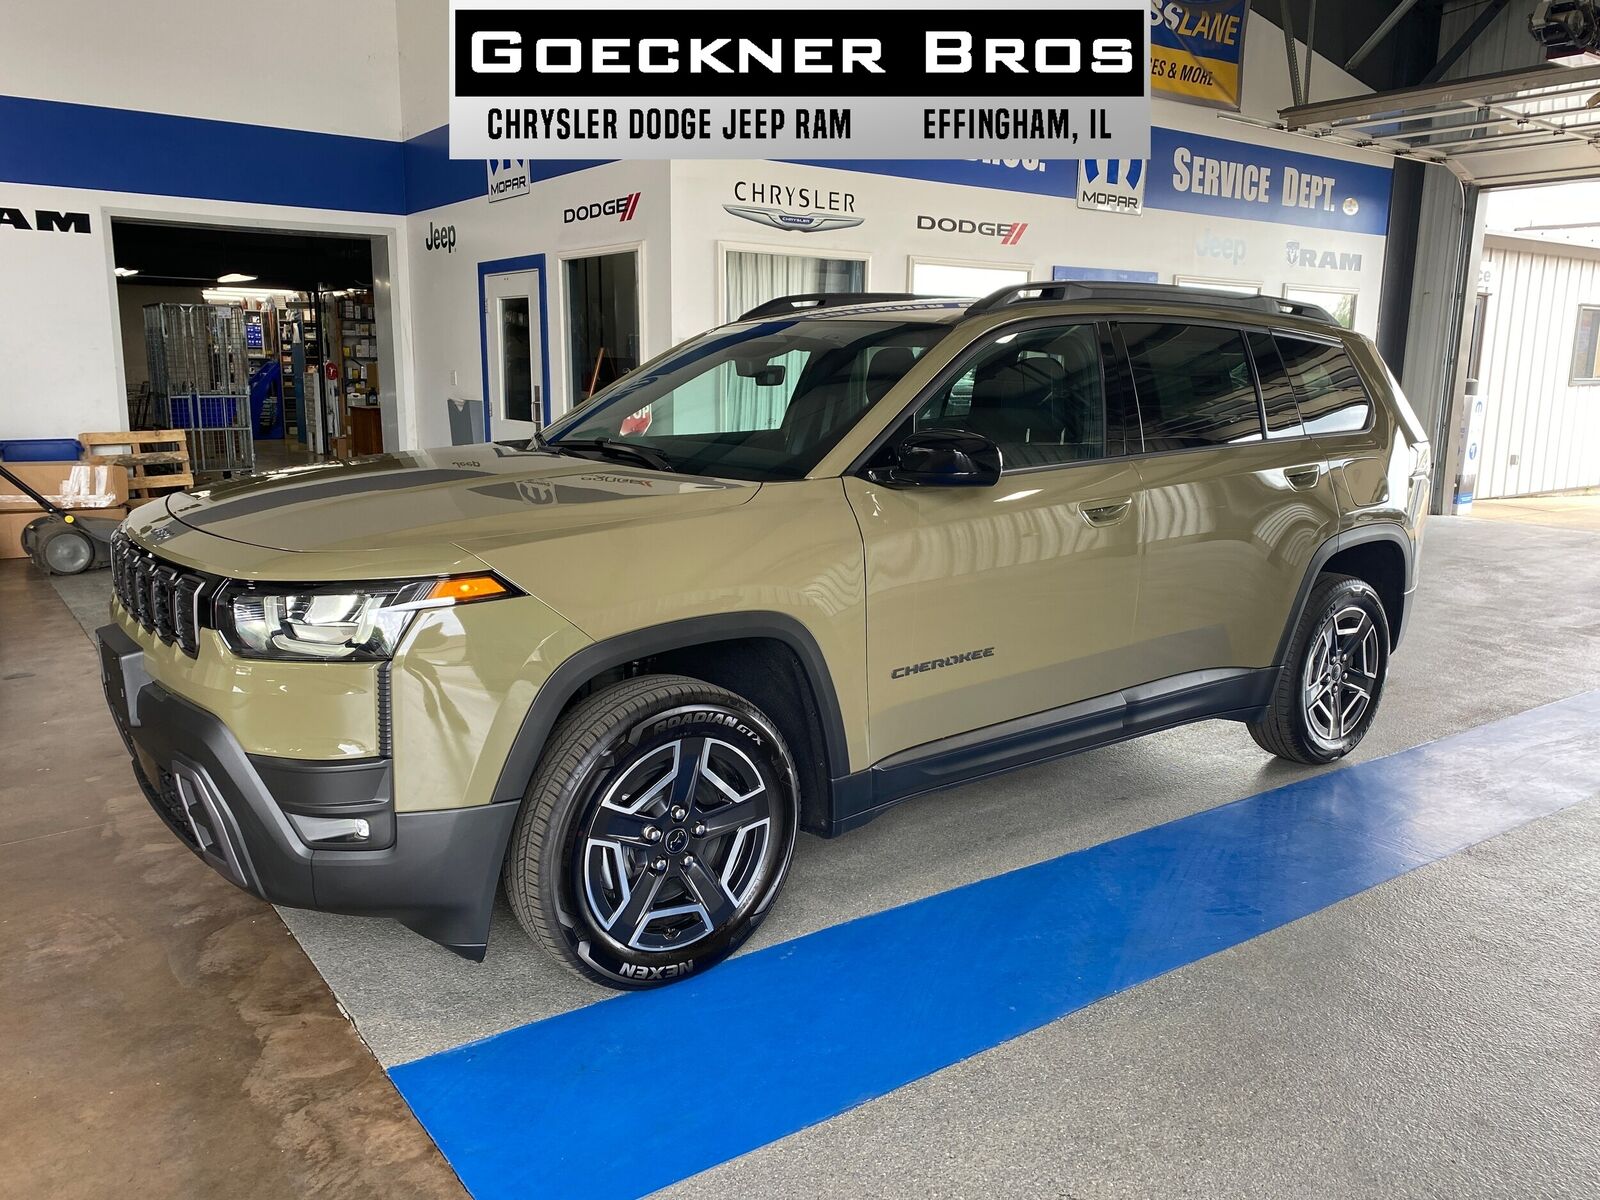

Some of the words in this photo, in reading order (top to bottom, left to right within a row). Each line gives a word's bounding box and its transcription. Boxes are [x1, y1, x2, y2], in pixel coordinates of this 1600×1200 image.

[1167, 62, 1177, 79] &
[1180, 64, 1213, 86] MORE
[490, 175, 527, 196] MOPAR
[734, 181, 855, 212] CHRYSLER
[564, 197, 628, 223] DODGE
[1082, 190, 1138, 209] MOPAR
[425, 221, 456, 254] Jeep
[917, 215, 1012, 237] DODGE
[1196, 229, 1247, 265] Jeep
[1300, 249, 1361, 271] RAM
[891, 646, 995, 679] CHEROKEE
[654, 712, 738, 735] ROADIAN
[737, 724, 764, 746] GTX
[619, 960, 694, 979] NEXEN
